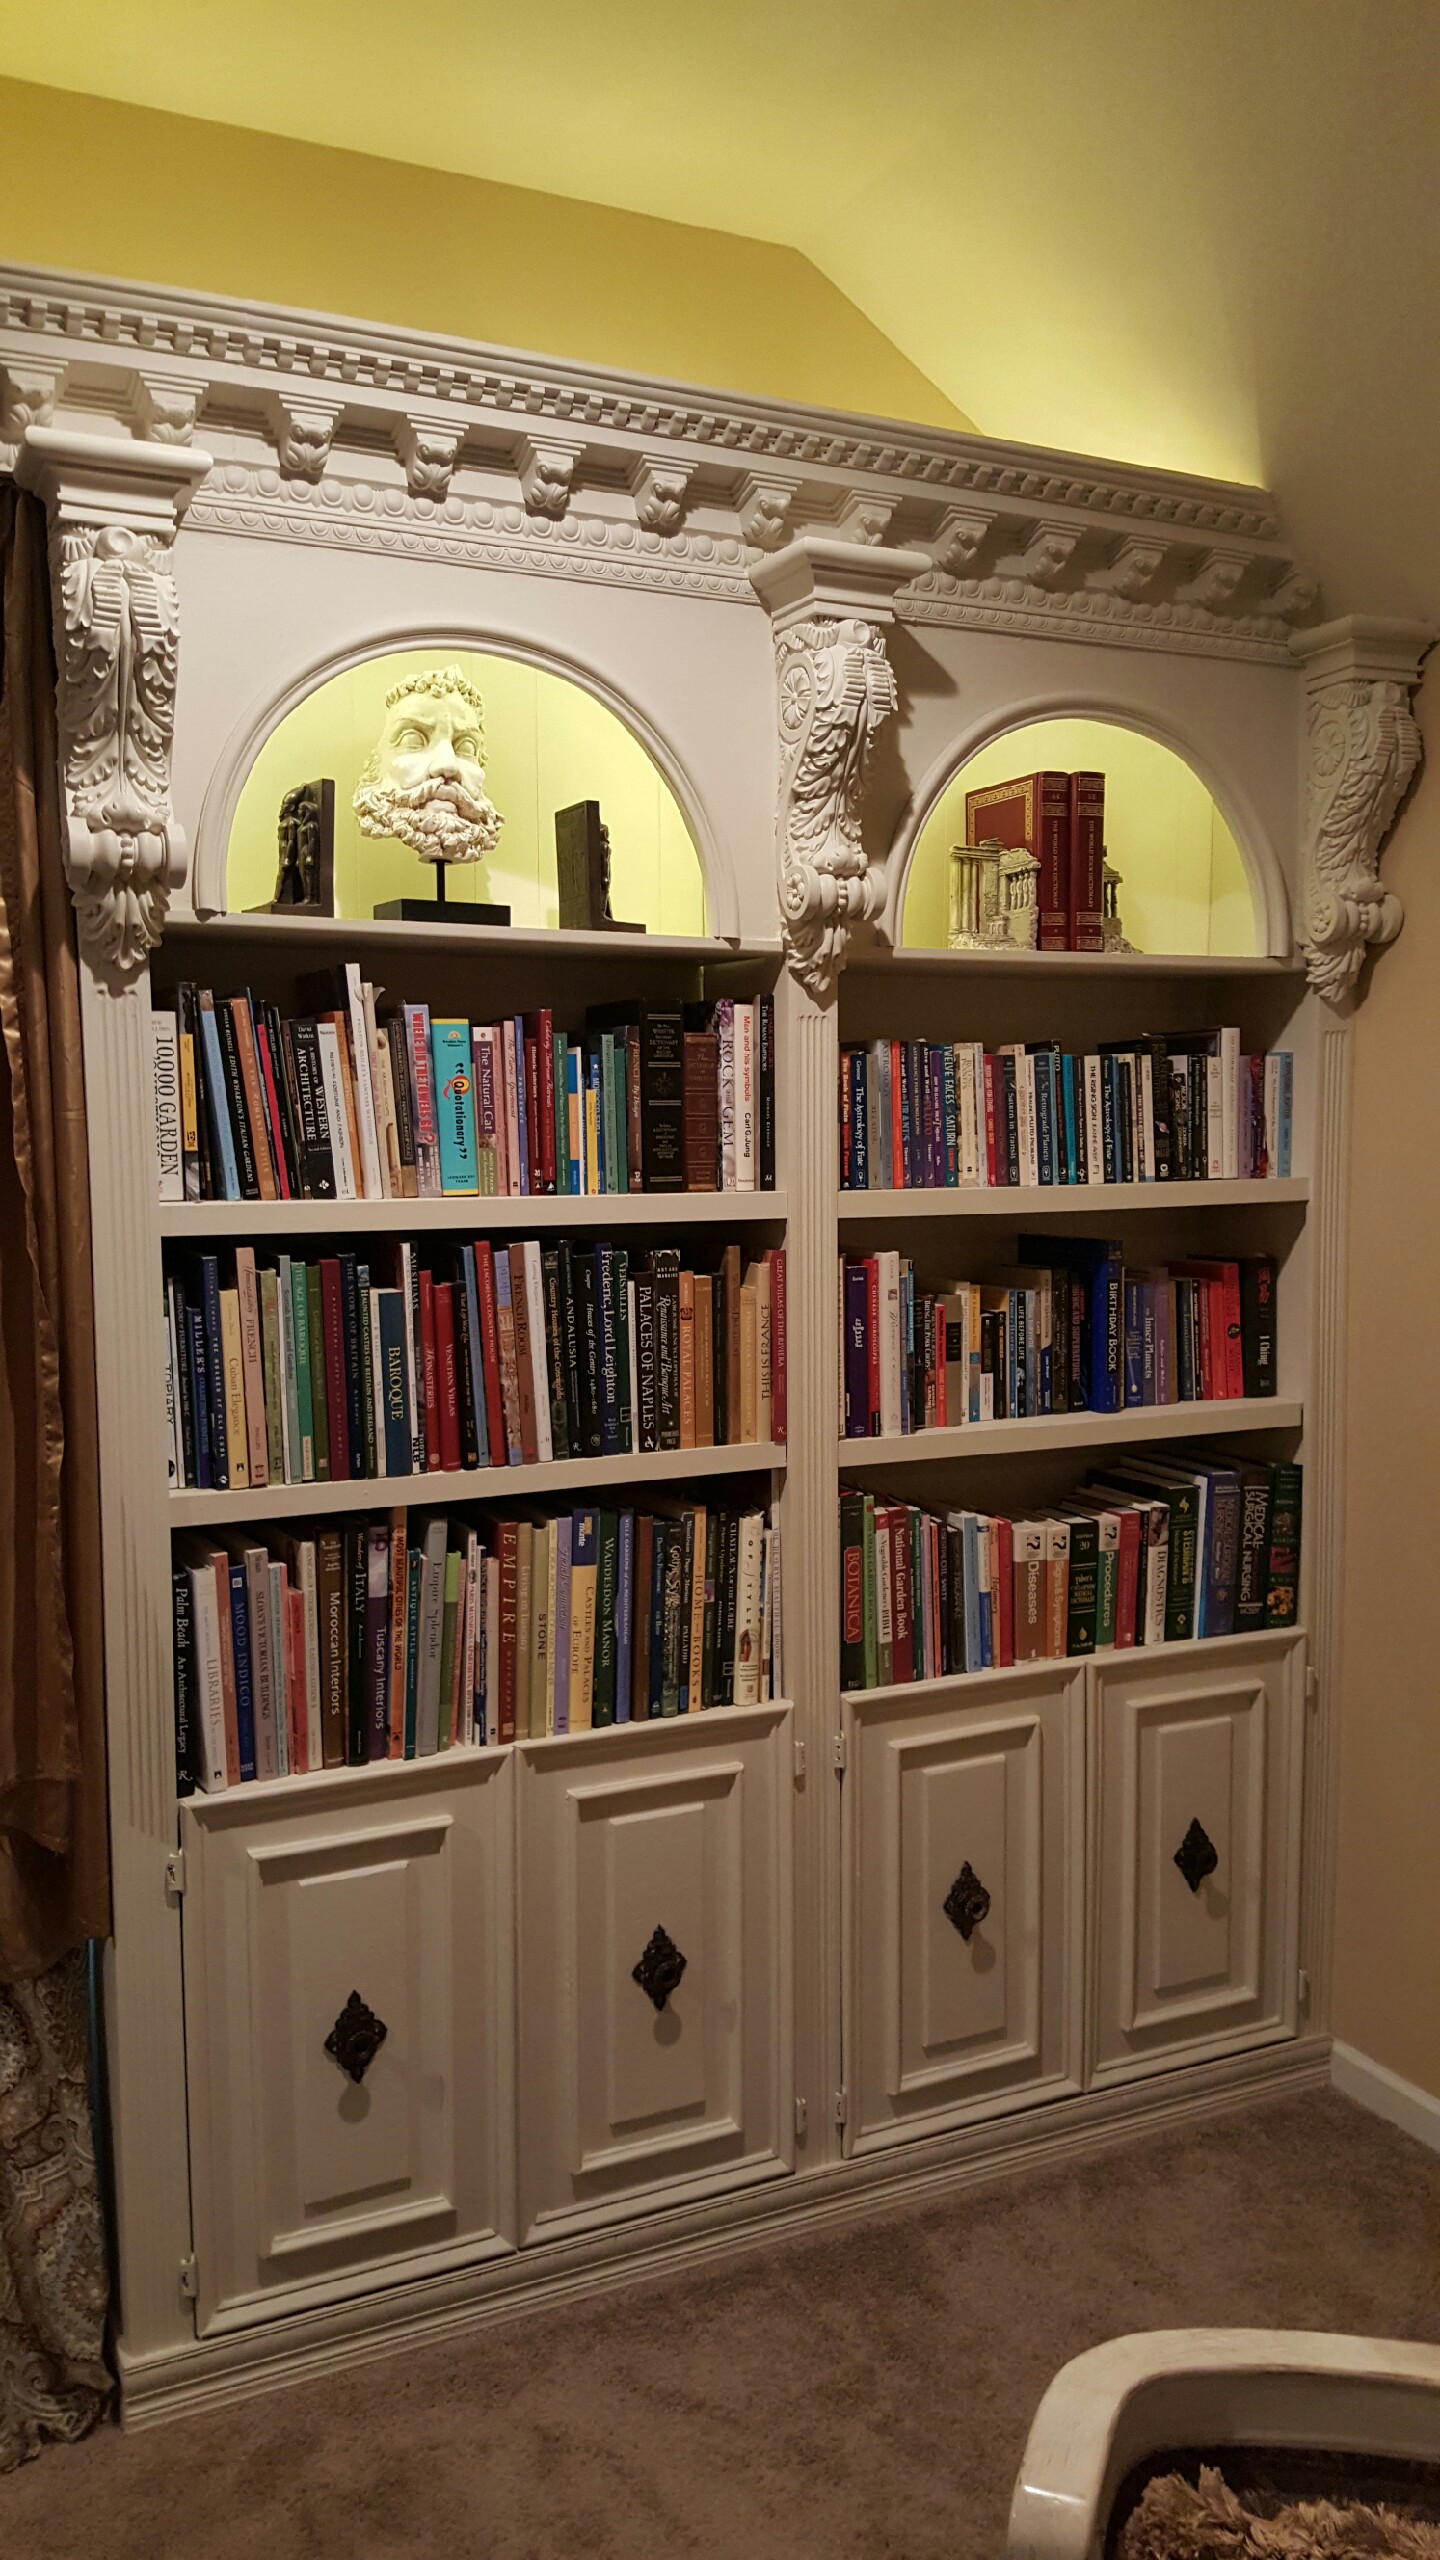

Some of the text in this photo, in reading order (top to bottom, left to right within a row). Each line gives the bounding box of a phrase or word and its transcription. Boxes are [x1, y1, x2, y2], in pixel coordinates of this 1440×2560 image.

[412, 1013, 425, 1044] WHERE
[414, 1046, 428, 1062] DID
[743, 1016, 751, 1032] Man
[297, 1047, 316, 1141] ARCHITECTURE
[309, 1052, 317, 1075] HISTORY
[313, 1076, 319, 1085] OF
[415, 1063, 429, 1081] THE
[480, 1046, 493, 1130] The Natural Cat
[743, 1067, 751, 1102] symbols
[856, 1087, 864, 1102] The
[944, 1045, 956, 1146] TWELVE FACES SATURN
[152, 1036, 178, 1176] 10,000 GARDEN
[229, 1055, 254, 1182] EDITH WHARTON'S ITALIAN GARDENS
[314, 1086, 329, 1139] WESTERN
[416, 1081, 431, 1117] TOWERS
[418, 1119, 436, 1145] GO?
[853, 1104, 863, 1139] Astrology
[902, 1100, 910, 1141] URANUS
[1008, 1092, 1017, 1159] Saturn in Transit
[1040, 1092, 1048, 1133] Retrograde
[1103, 1101, 1112, 1134] Astrology
[855, 1140, 865, 1150] of
[1105, 1134, 1113, 1143] of
[776, 1259, 784, 1282] GREAT
[513, 1274, 528, 1356] FRENCH ROOM
[548, 1277, 564, 1400] Country Houses of the Cotswolds
[565, 1297, 577, 1368] ANDALUSIA
[601, 1250, 617, 1404] Frederic, Lord Leighton
[777, 1310, 784, 1319] OF
[777, 1320, 785, 1335] THE
[1108, 1282, 1118, 1371] BIRTHDAY BOOK
[1144, 1317, 1154, 1379] Inner Planets
[360, 1289, 375, 1443] HAUNTED CASTLES OF BRITAIN AND IRELAND
[388, 1346, 404, 1421] BAROQUE
[425, 1343, 436, 1409] MONASTERIES
[445, 1343, 456, 1417] VENETIAN VILLAS
[639, 1286, 654, 1430] PALACES OF NAPLES
[656, 1295, 672, 1414] Renaissance and Baroque Art
[682, 1325, 693, 1425] ROYAL PALACES
[228, 1358, 242, 1436] Cuban Elegance
[1240, 1491, 1254, 1601] SURGICAL NURSING
[1252, 1491, 1265, 1549] MEDICAL-
[502, 1533, 517, 1644] EMPIRE
[601, 1537, 615, 1668] WADDESDON MANOR
[847, 1552, 861, 1638] BOTANICA
[894, 1527, 908, 1639] National Garden Book
[991, 1576, 1000, 1614] Perfumery
[1027, 1562, 1039, 1624] Diseases
[1053, 1560, 1064, 1588] Signs
[1102, 1551, 1113, 1627] Procedures
[428, 1562, 443, 1659] Empire Splendor
[537, 1613, 547, 1660] STONE
[1052, 1595, 1063, 1647] Symptoms
[175, 1588, 190, 1753] Palm Beach An Architectural Legacy
[329, 1591, 343, 1715] Moroccan Interiors
[374, 1626, 387, 1729] Tuscany Interiors
[571, 1616, 582, 1675] OF EUROPE
[582, 1586, 595, 1704] CASTLES AND PALACES
[206, 1659, 220, 1726] LIBRARIES
